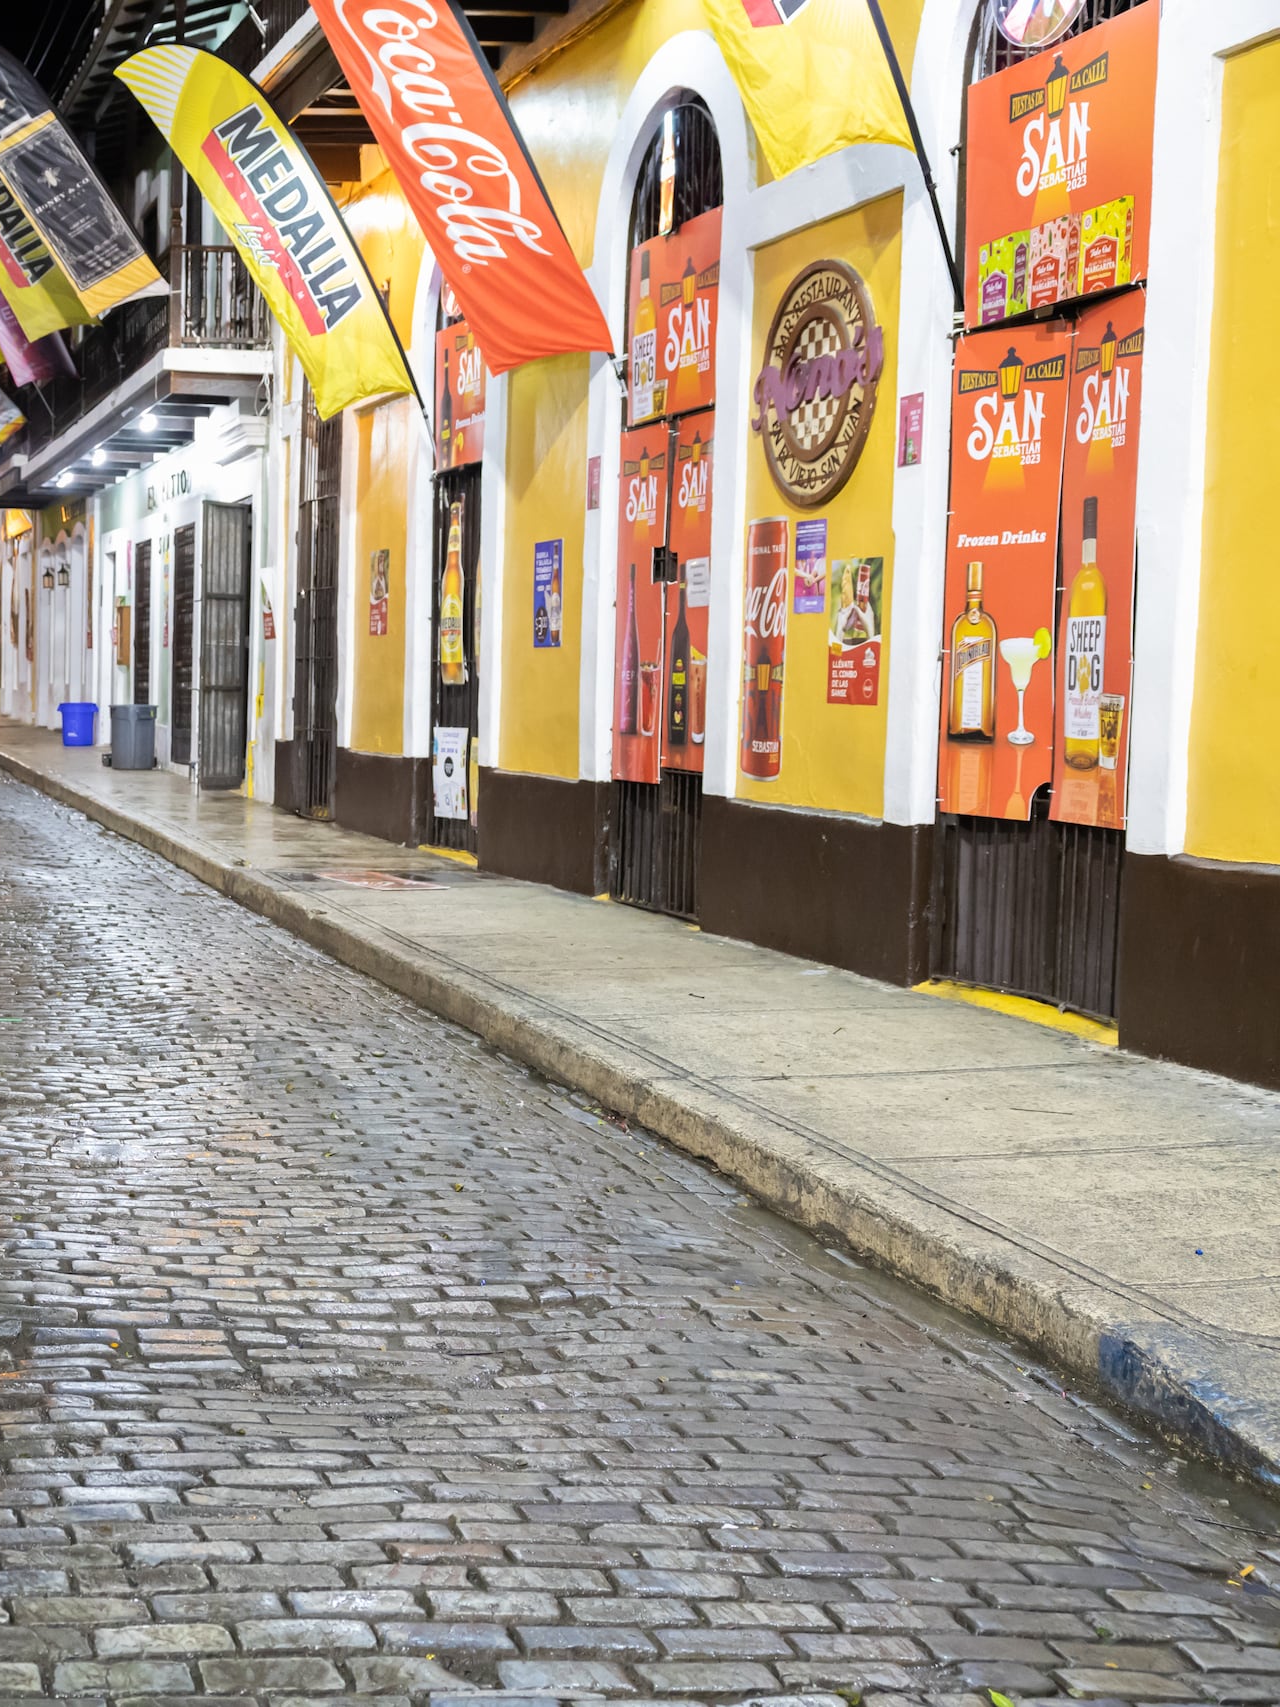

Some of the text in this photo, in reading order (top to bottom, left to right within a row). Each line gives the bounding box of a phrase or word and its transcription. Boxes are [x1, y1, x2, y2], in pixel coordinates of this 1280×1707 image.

[1071, 61, 1107, 90] LA CALLE
[1016, 102, 1091, 197] SAN
[1066, 175, 1087, 192] 2023
[214, 102, 363, 333] MEDALLA
[225, 171, 305, 301] PREMIUM
[234, 222, 280, 271] Light
[634, 332, 655, 360] SHEEP
[664, 297, 711, 372] SAN
[1118, 333, 1143, 355] LA CALLE
[457, 346, 482, 396] SAN
[960, 358, 1063, 393] FIESTAS DE LA CALLE
[967, 388, 1046, 461] SAN
[1076, 366, 1131, 445] SAN
[771, 418, 783, 445] EN
[788, 459, 818, 490] VIEJO
[820, 452, 841, 484] SAN
[840, 398, 863, 455] JUAN
[1020, 454, 1041, 465] 2023
[1111, 435, 1126, 448] 2023
[625, 474, 658, 522] SAN
[679, 459, 708, 508] SAN
[957, 530, 1047, 548] Frozen Drinks
[1070, 620, 1101, 652] SHEEP
